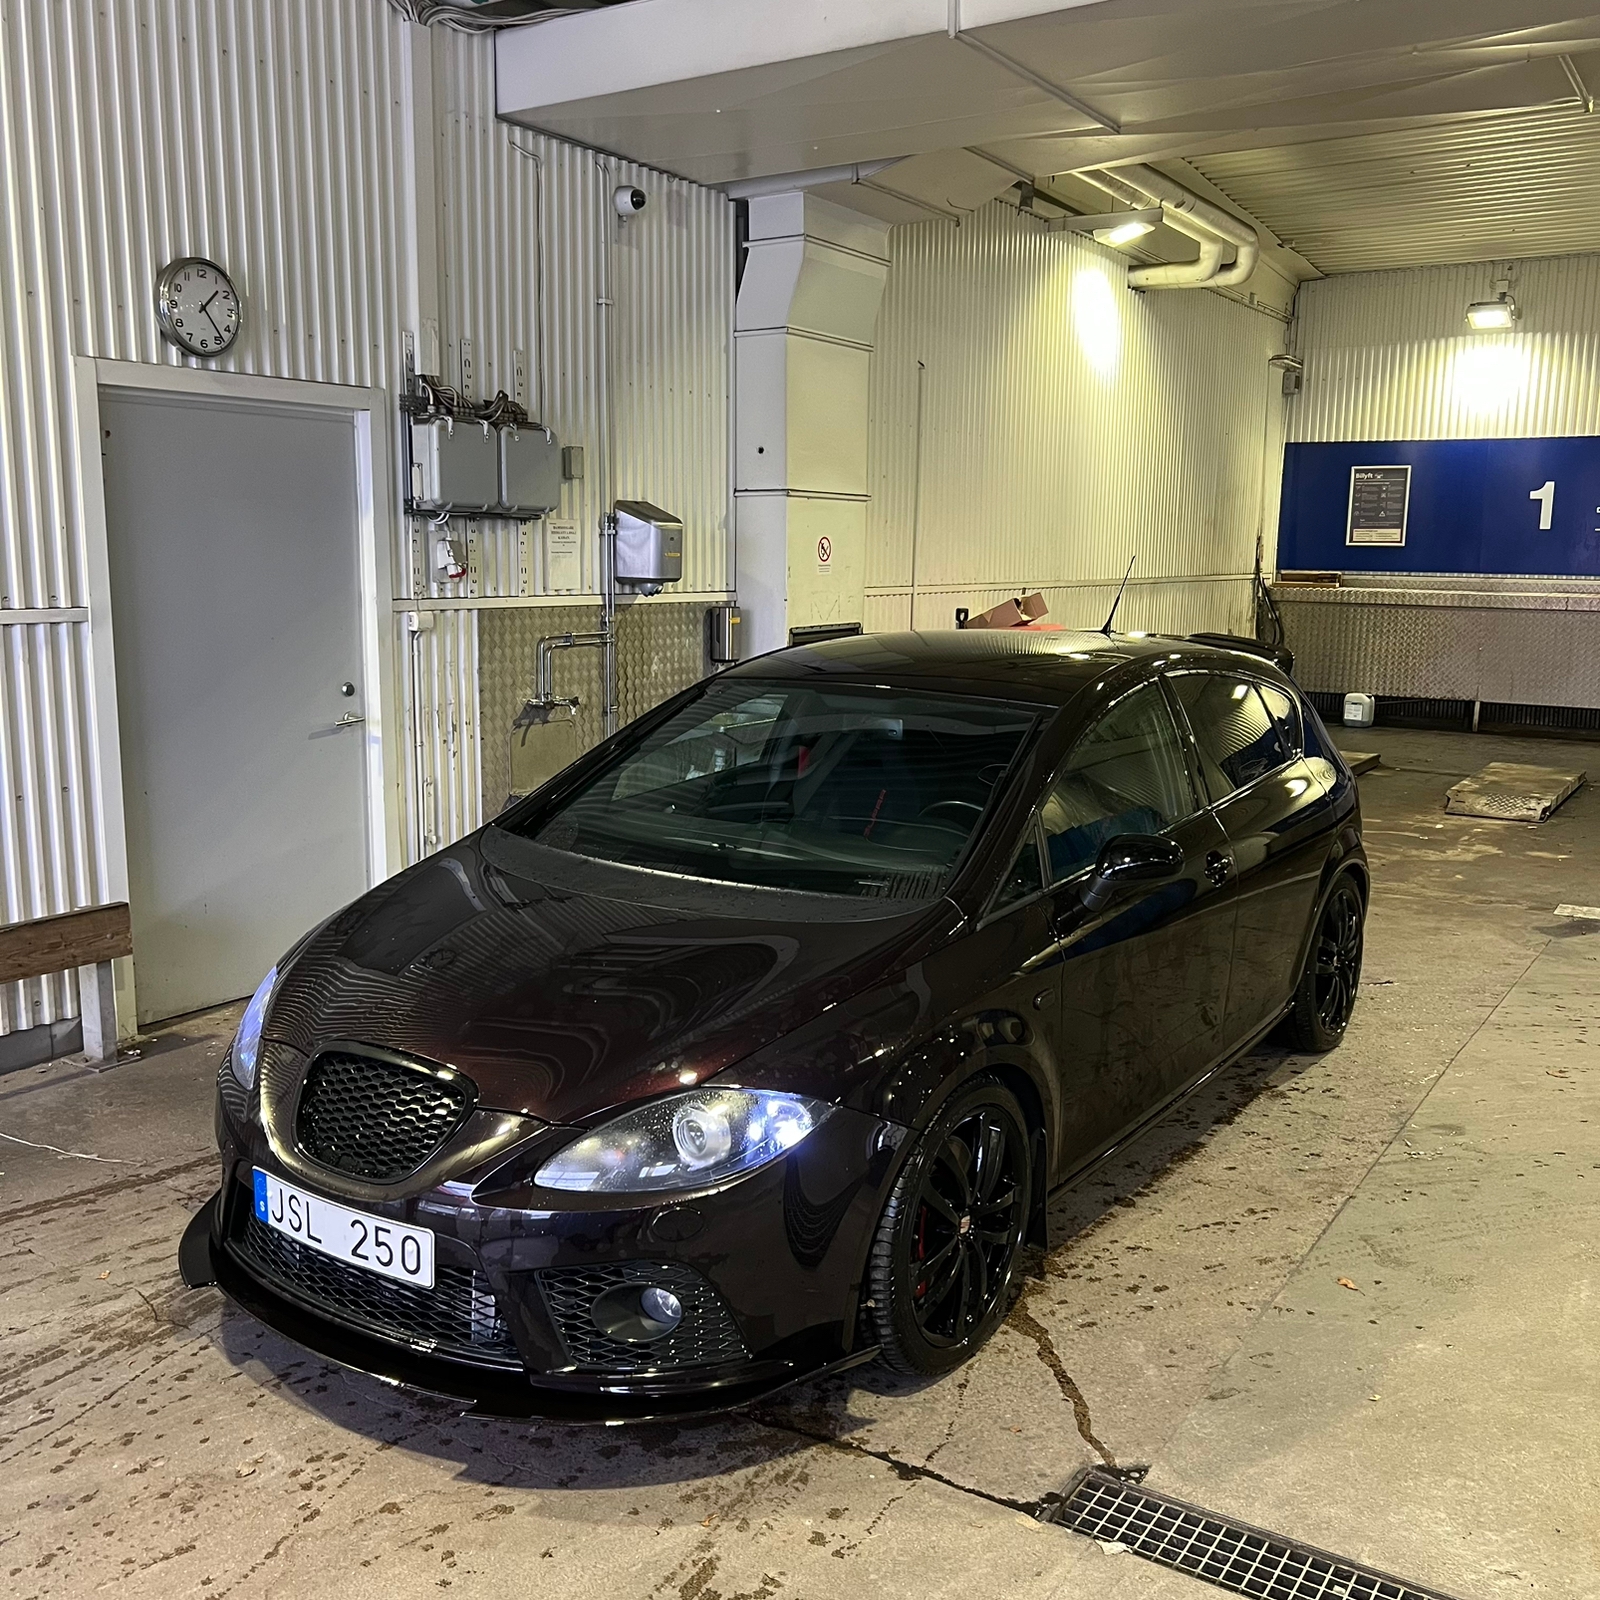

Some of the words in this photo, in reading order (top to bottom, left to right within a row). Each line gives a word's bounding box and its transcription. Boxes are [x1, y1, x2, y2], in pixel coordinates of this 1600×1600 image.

[184, 271, 190, 281] 11
[197, 268, 207, 279] 12
[174, 283, 182, 293] 10
[222, 290, 230, 300] 2
[170, 299, 178, 309] 9
[175, 318, 184, 328] 8
[224, 324, 231, 334] 4
[186, 332, 193, 342] 7
[214, 336, 222, 346] 5
[200, 339, 208, 349] 6
[1355, 472, 1373, 480] Billyft
[1530, 481, 1555, 530] 1
[259, 1200, 266, 1212] S
[271, 1188, 322, 1244] JSL
[350, 1219, 421, 1275] 250
